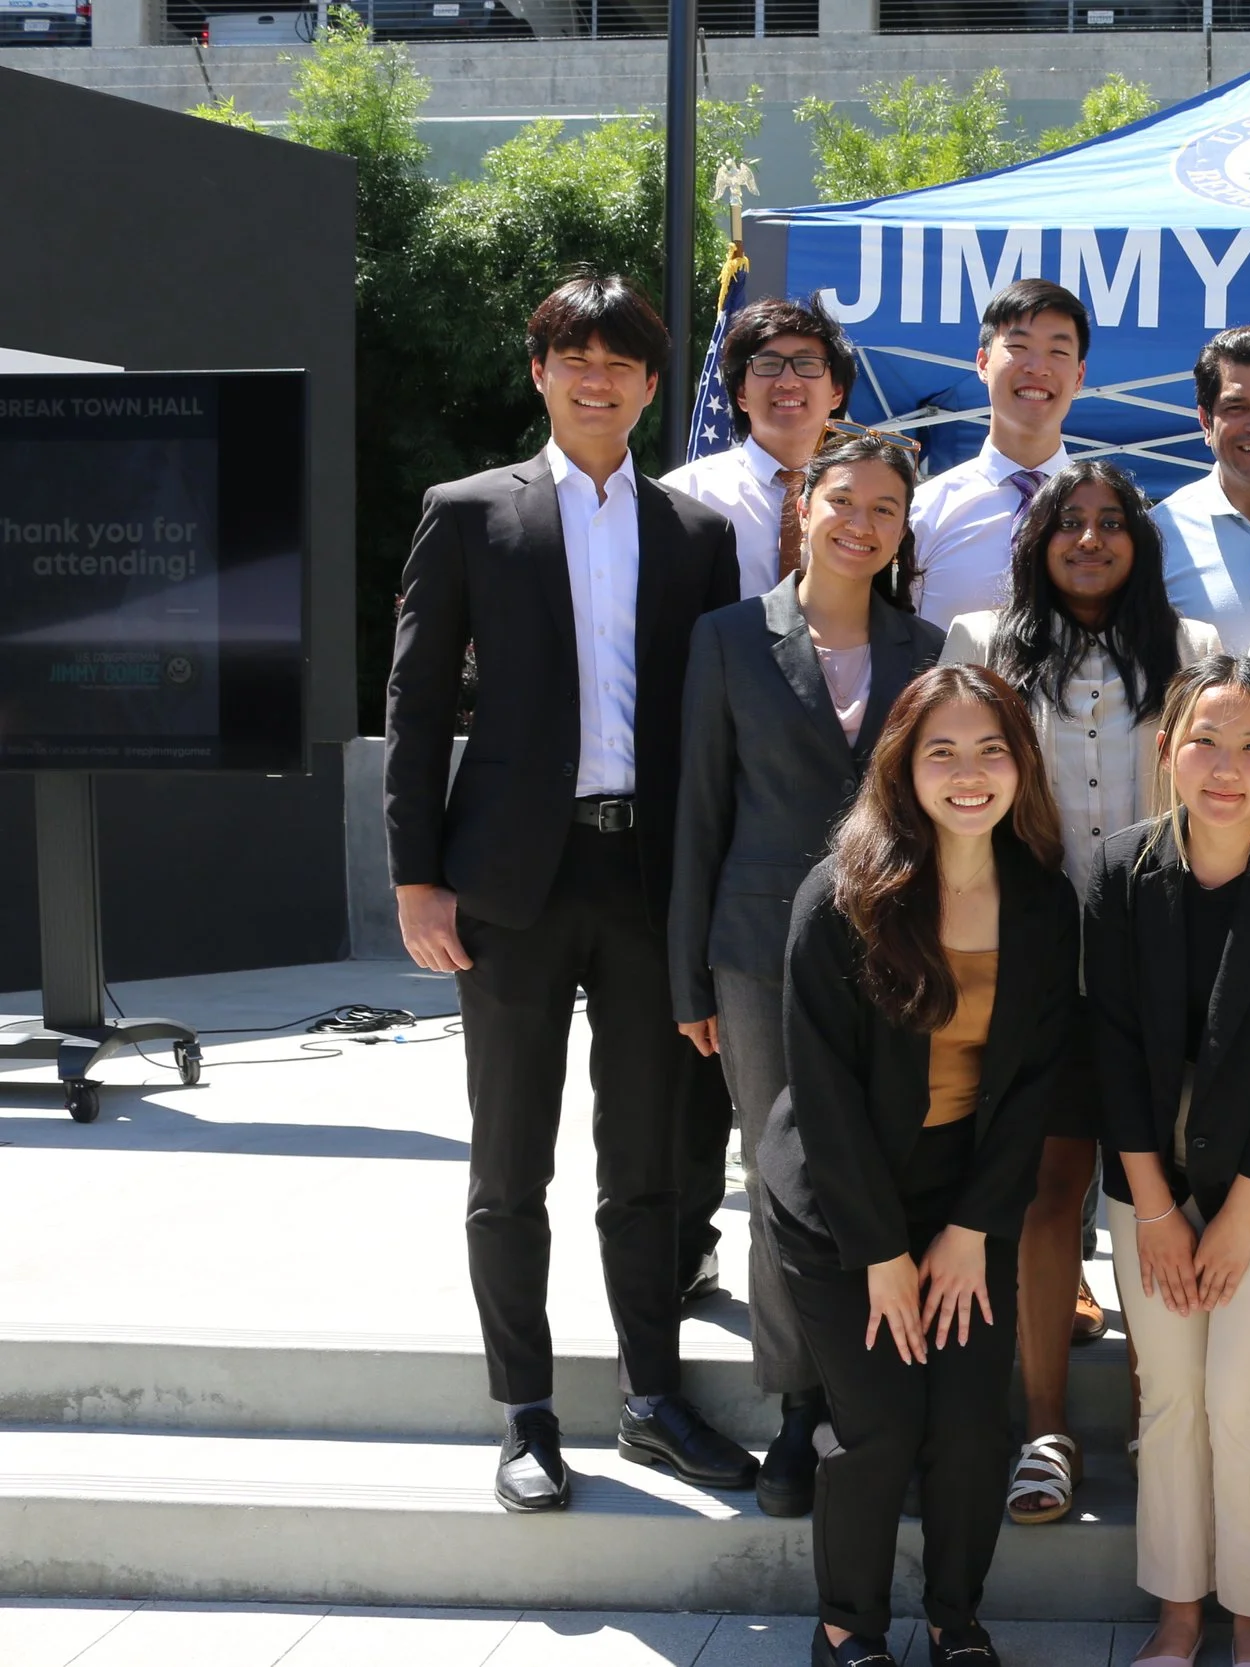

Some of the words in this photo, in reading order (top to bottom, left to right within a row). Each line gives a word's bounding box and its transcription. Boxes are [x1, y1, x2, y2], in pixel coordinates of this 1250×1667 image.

[71, 397, 142, 417] TOWN
[148, 396, 205, 417] HALL
[0, 516, 80, 543] hank
[87, 522, 144, 550] you
[153, 516, 198, 543] for
[32, 548, 196, 581] attending!
[49, 663, 99, 682] JIMMY
[104, 662, 160, 683] GOMEZ
